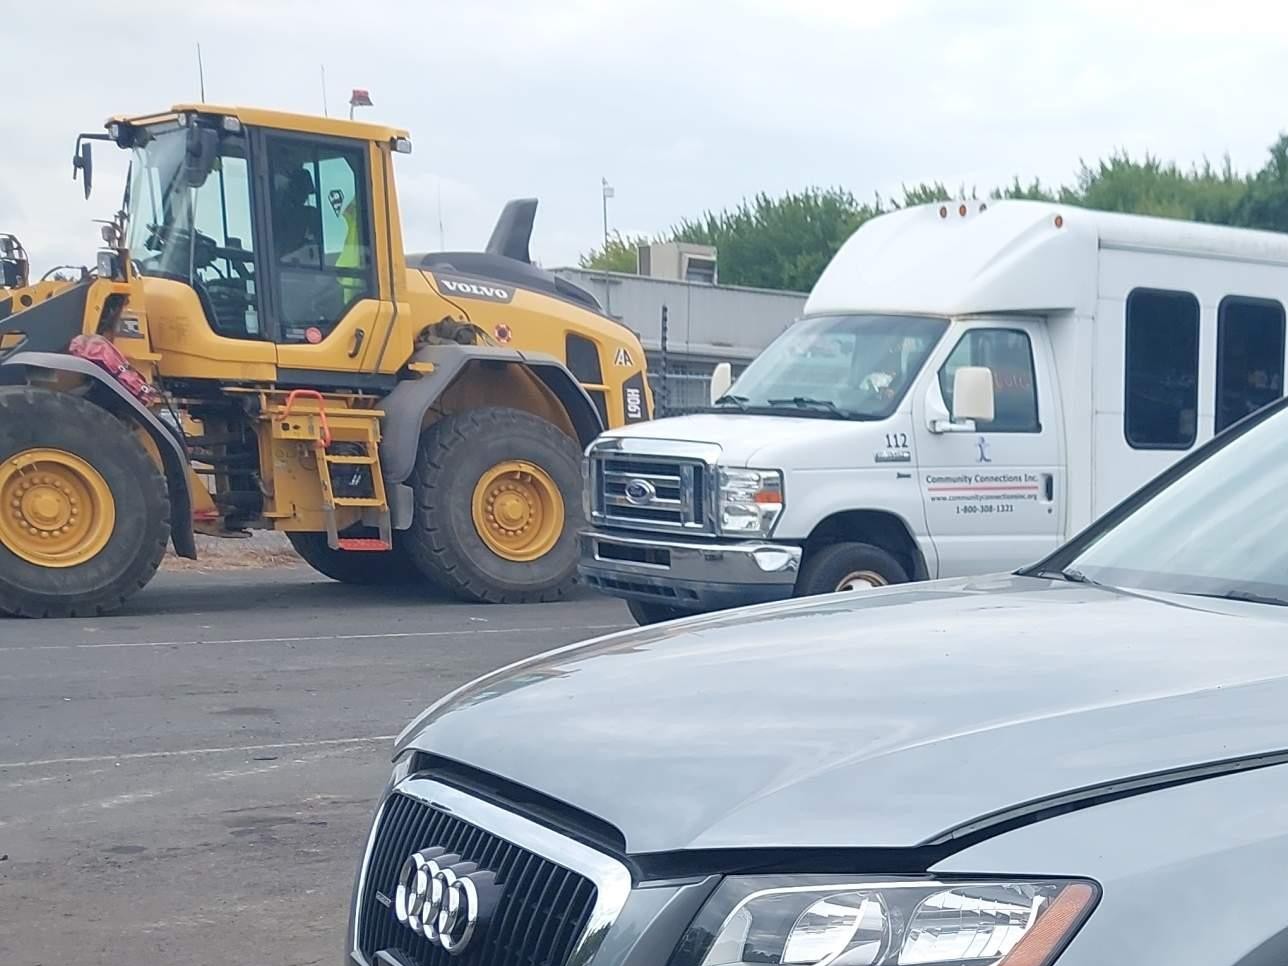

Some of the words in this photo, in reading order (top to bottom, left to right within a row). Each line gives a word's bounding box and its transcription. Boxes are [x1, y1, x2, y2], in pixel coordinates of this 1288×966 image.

[441, 279, 508, 298] VOLVO
[627, 388, 641, 418] L90H
[886, 433, 909, 448] 112
[926, 475, 972, 485] Community
[974, 474, 1022, 482] Connections
[1025, 473, 1039, 482] Inc.
